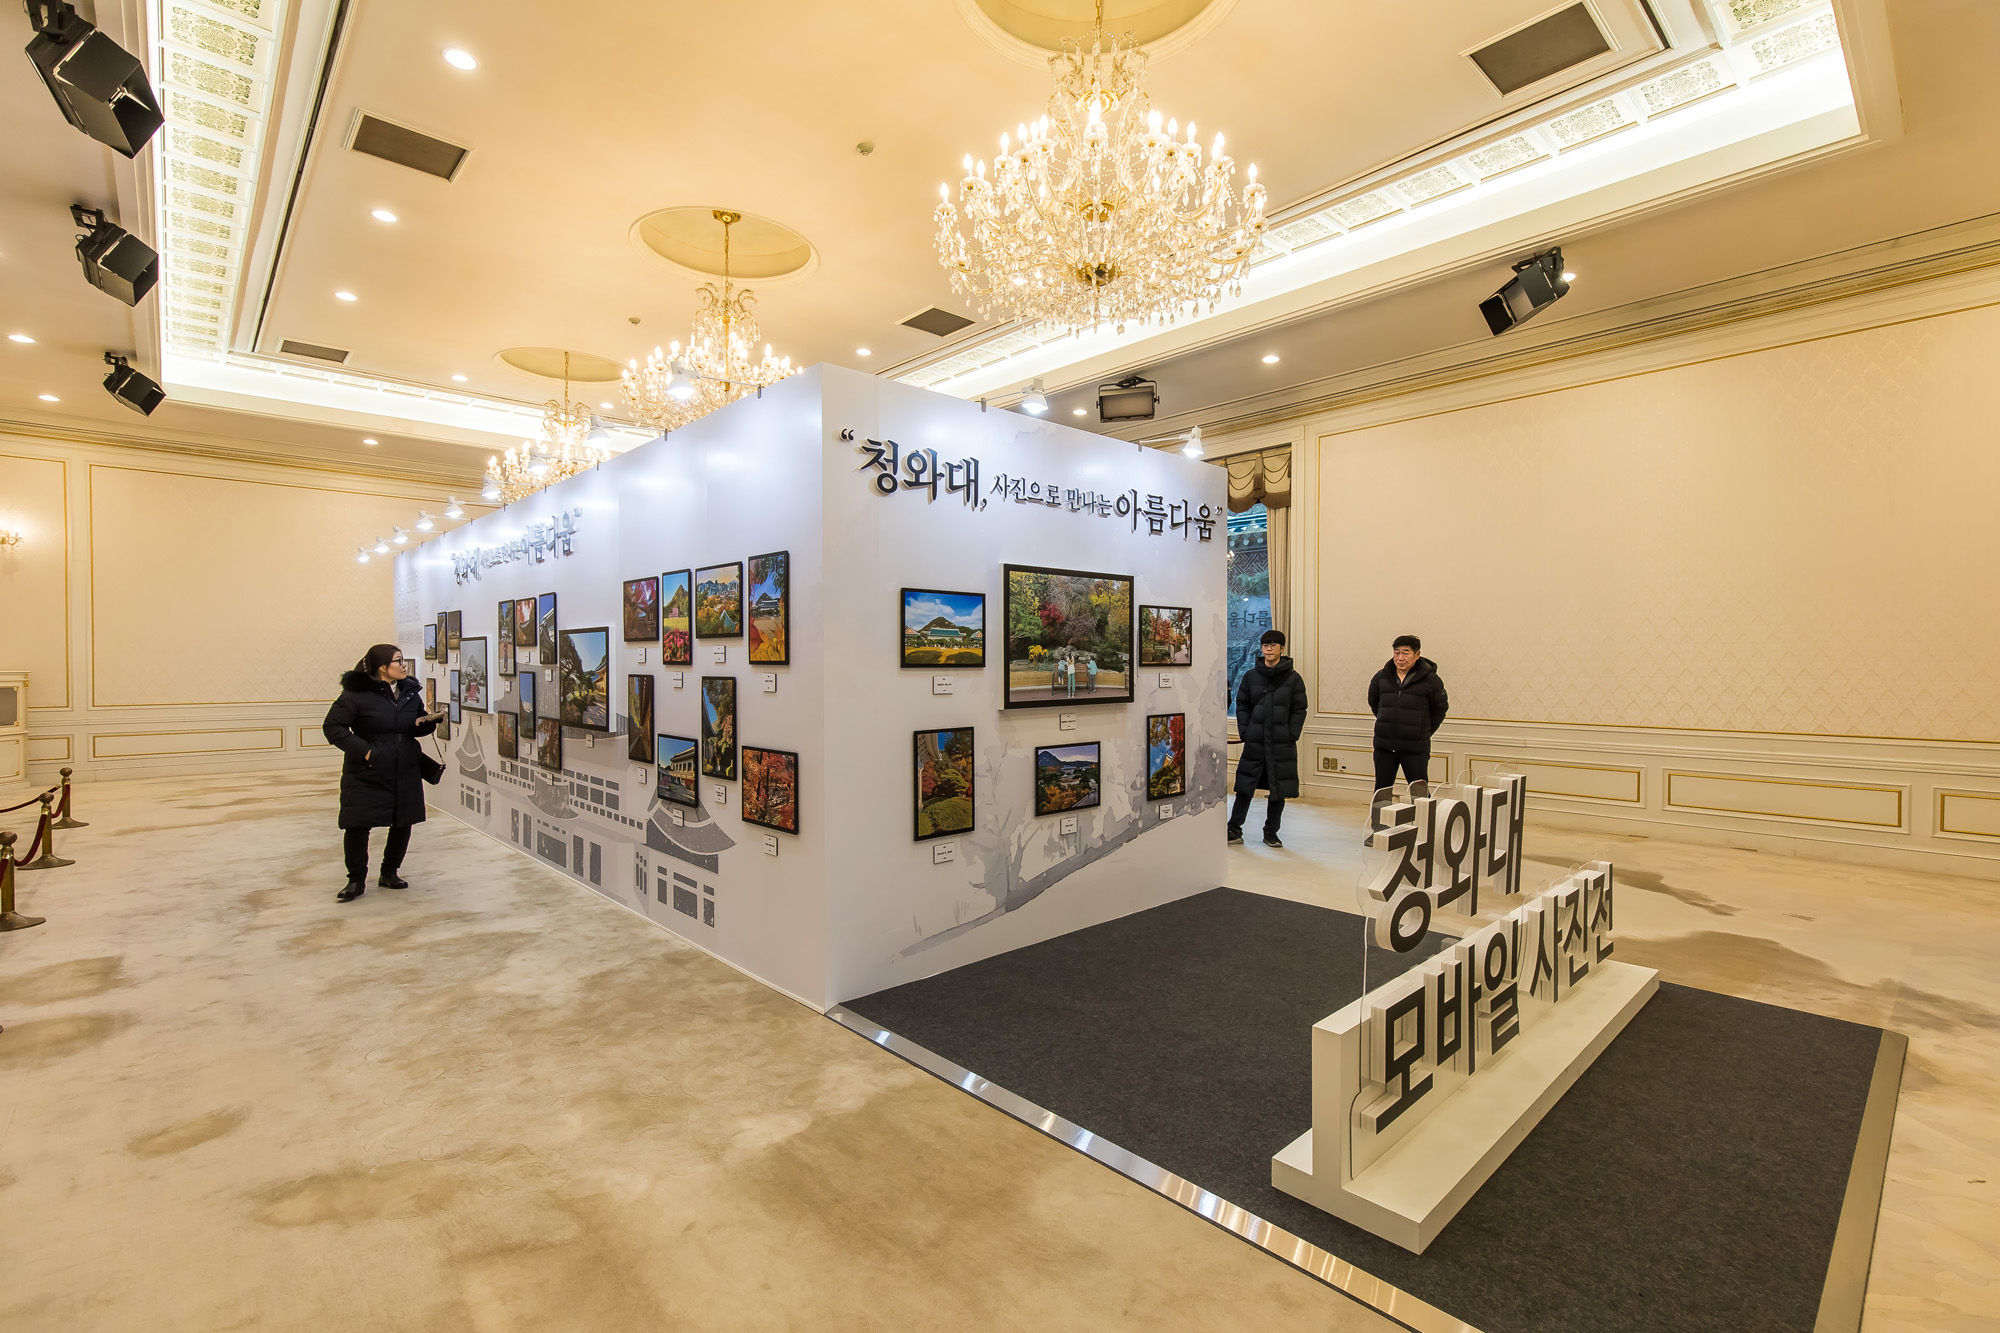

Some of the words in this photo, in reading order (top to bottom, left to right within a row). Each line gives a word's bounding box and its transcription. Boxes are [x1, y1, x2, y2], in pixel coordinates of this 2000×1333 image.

[990, 473, 1062, 507] 사진으로
[1067, 487, 1113, 517] 만나는
[1368, 774, 1526, 953] 청와대
[1361, 918, 1519, 1135] 모바일
[1518, 861, 1614, 1003] 사진전
